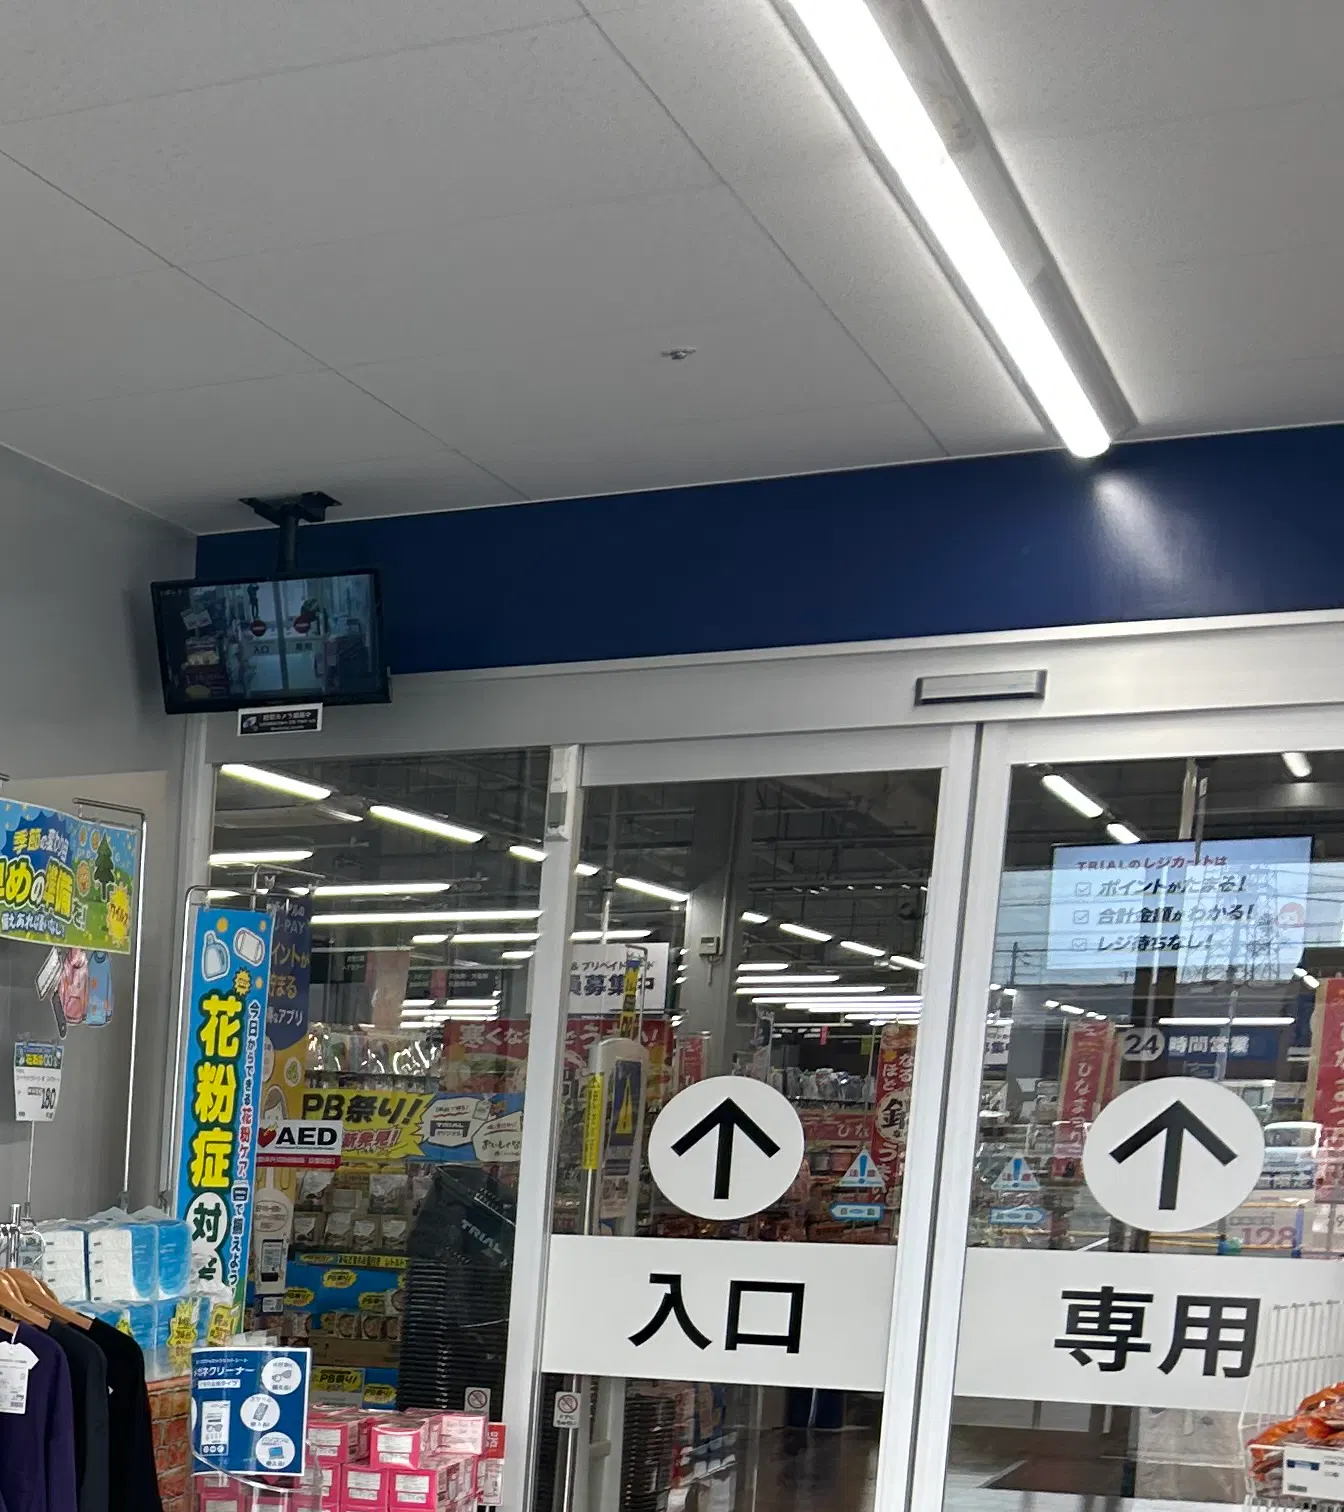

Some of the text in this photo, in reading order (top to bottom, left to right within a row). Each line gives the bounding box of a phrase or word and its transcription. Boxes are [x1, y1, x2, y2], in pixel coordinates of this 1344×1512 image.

[271, 941, 310, 968] イントが
[569, 974, 655, 996] 員募集中
[1124, 1033, 1160, 1055] 24
[275, 1126, 338, 1146] AED
[461, 1219, 503, 1255] TRIAL
[628, 1273, 1262, 1379] 入口 専用
